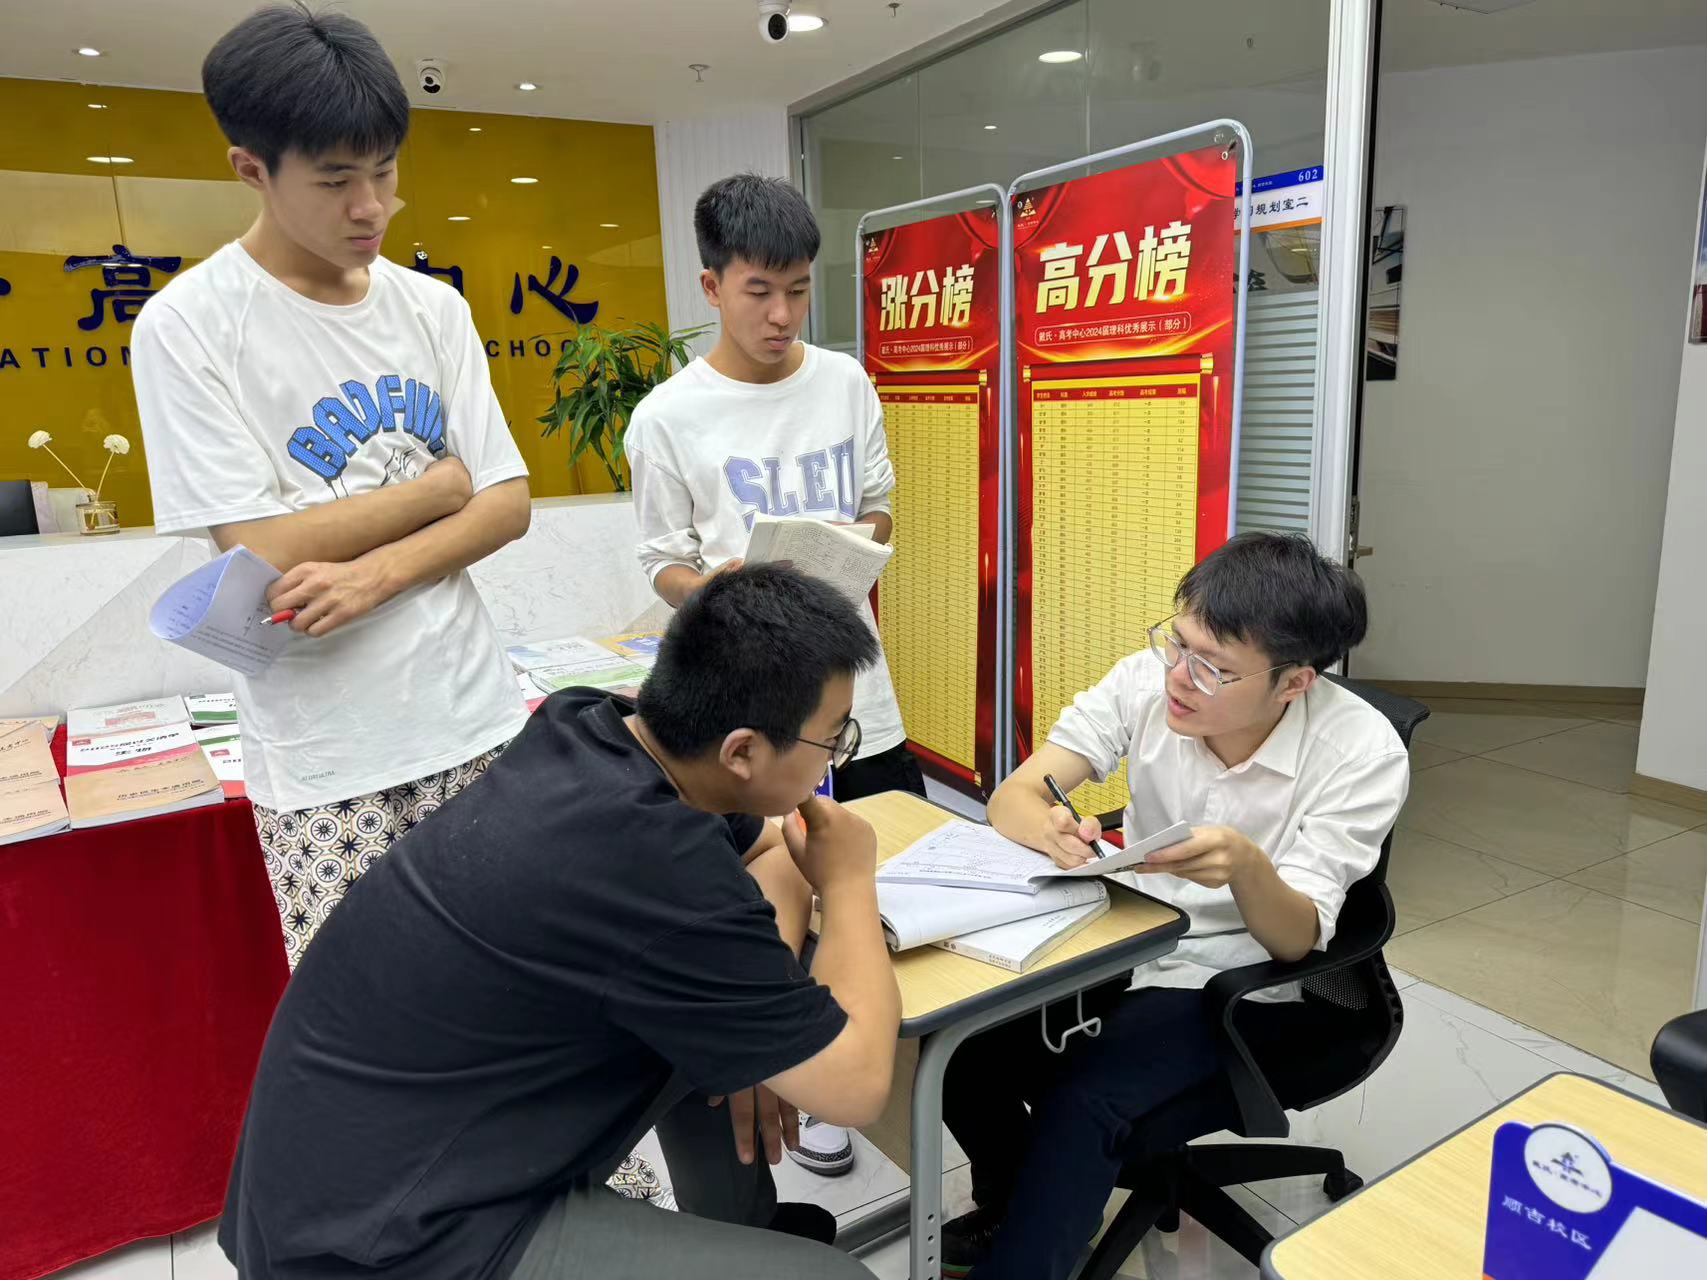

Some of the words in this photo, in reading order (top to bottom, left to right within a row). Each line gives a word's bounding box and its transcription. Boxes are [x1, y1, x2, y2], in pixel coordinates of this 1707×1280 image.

[1298, 169, 1318, 182] 602
[879, 263, 975, 332] 涨分榜
[1035, 220, 1192, 314] 高分榜
